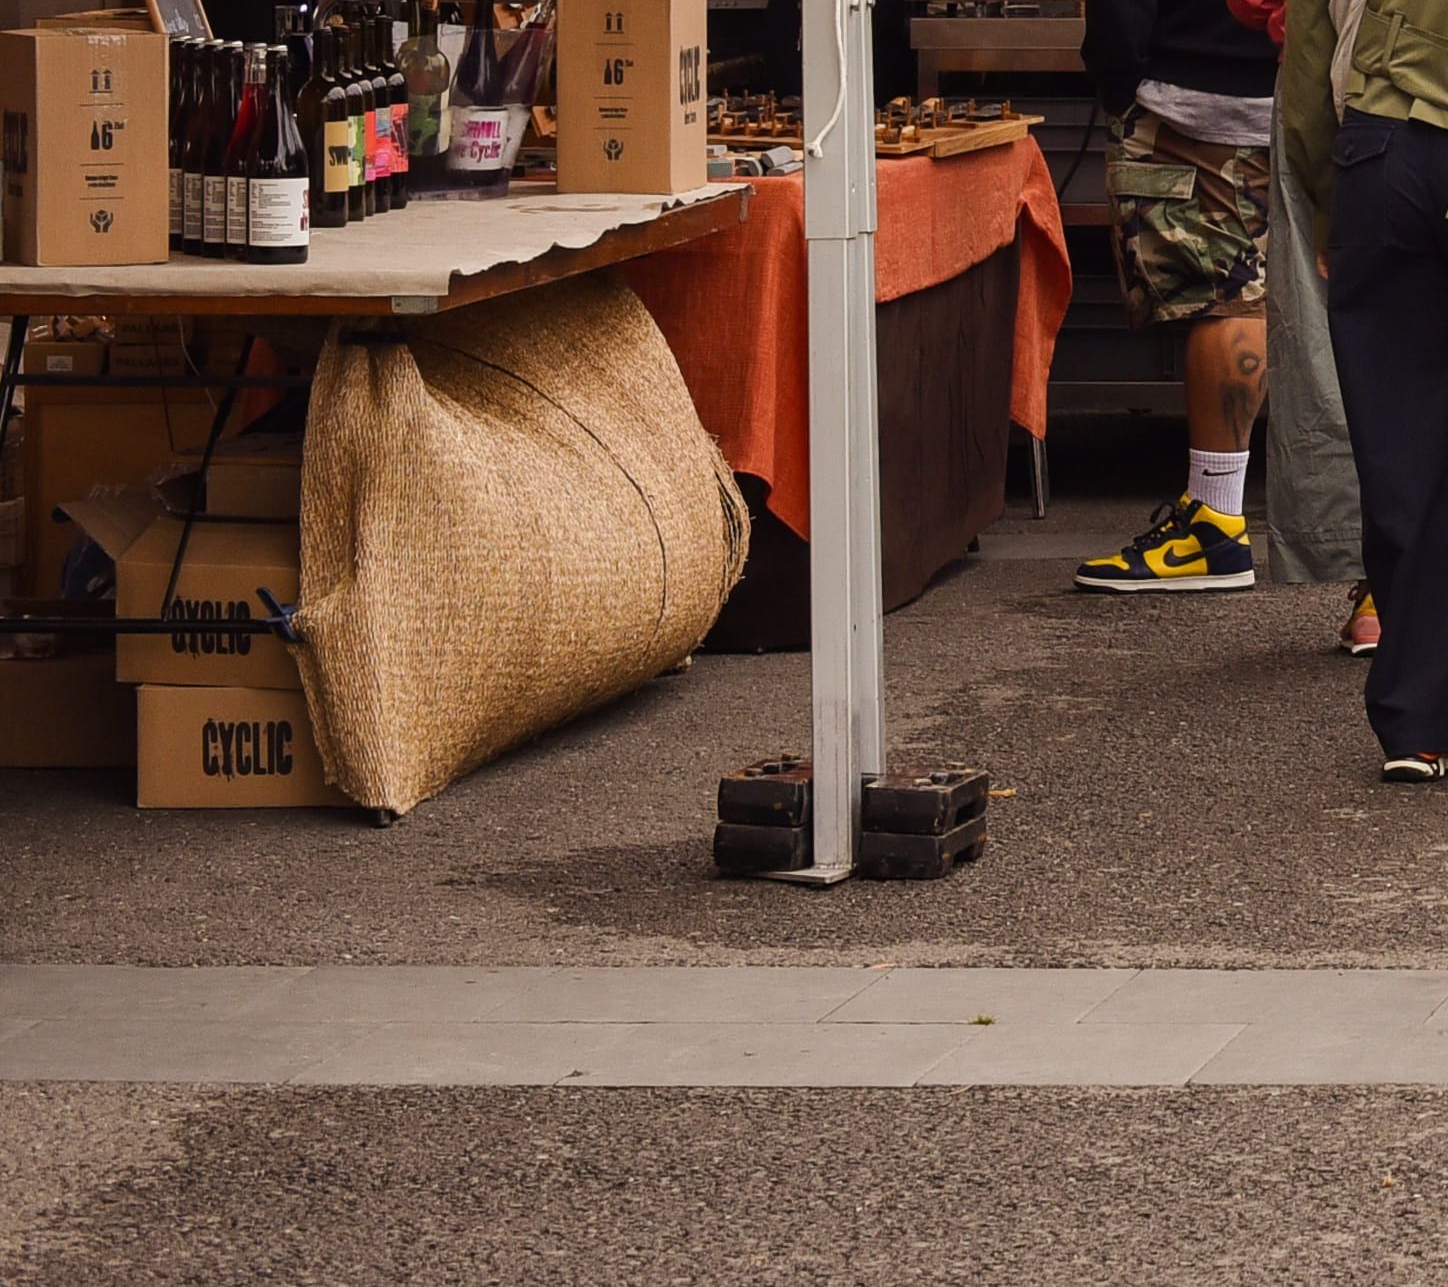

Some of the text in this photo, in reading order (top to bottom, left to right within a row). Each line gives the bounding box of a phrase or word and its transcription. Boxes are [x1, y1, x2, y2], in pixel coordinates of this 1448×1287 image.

[614, 58, 625, 85] 6
[101, 119, 113, 150] 6
[171, 596, 251, 658] CYCLIC
[202, 718, 293, 781] CYCLIC
